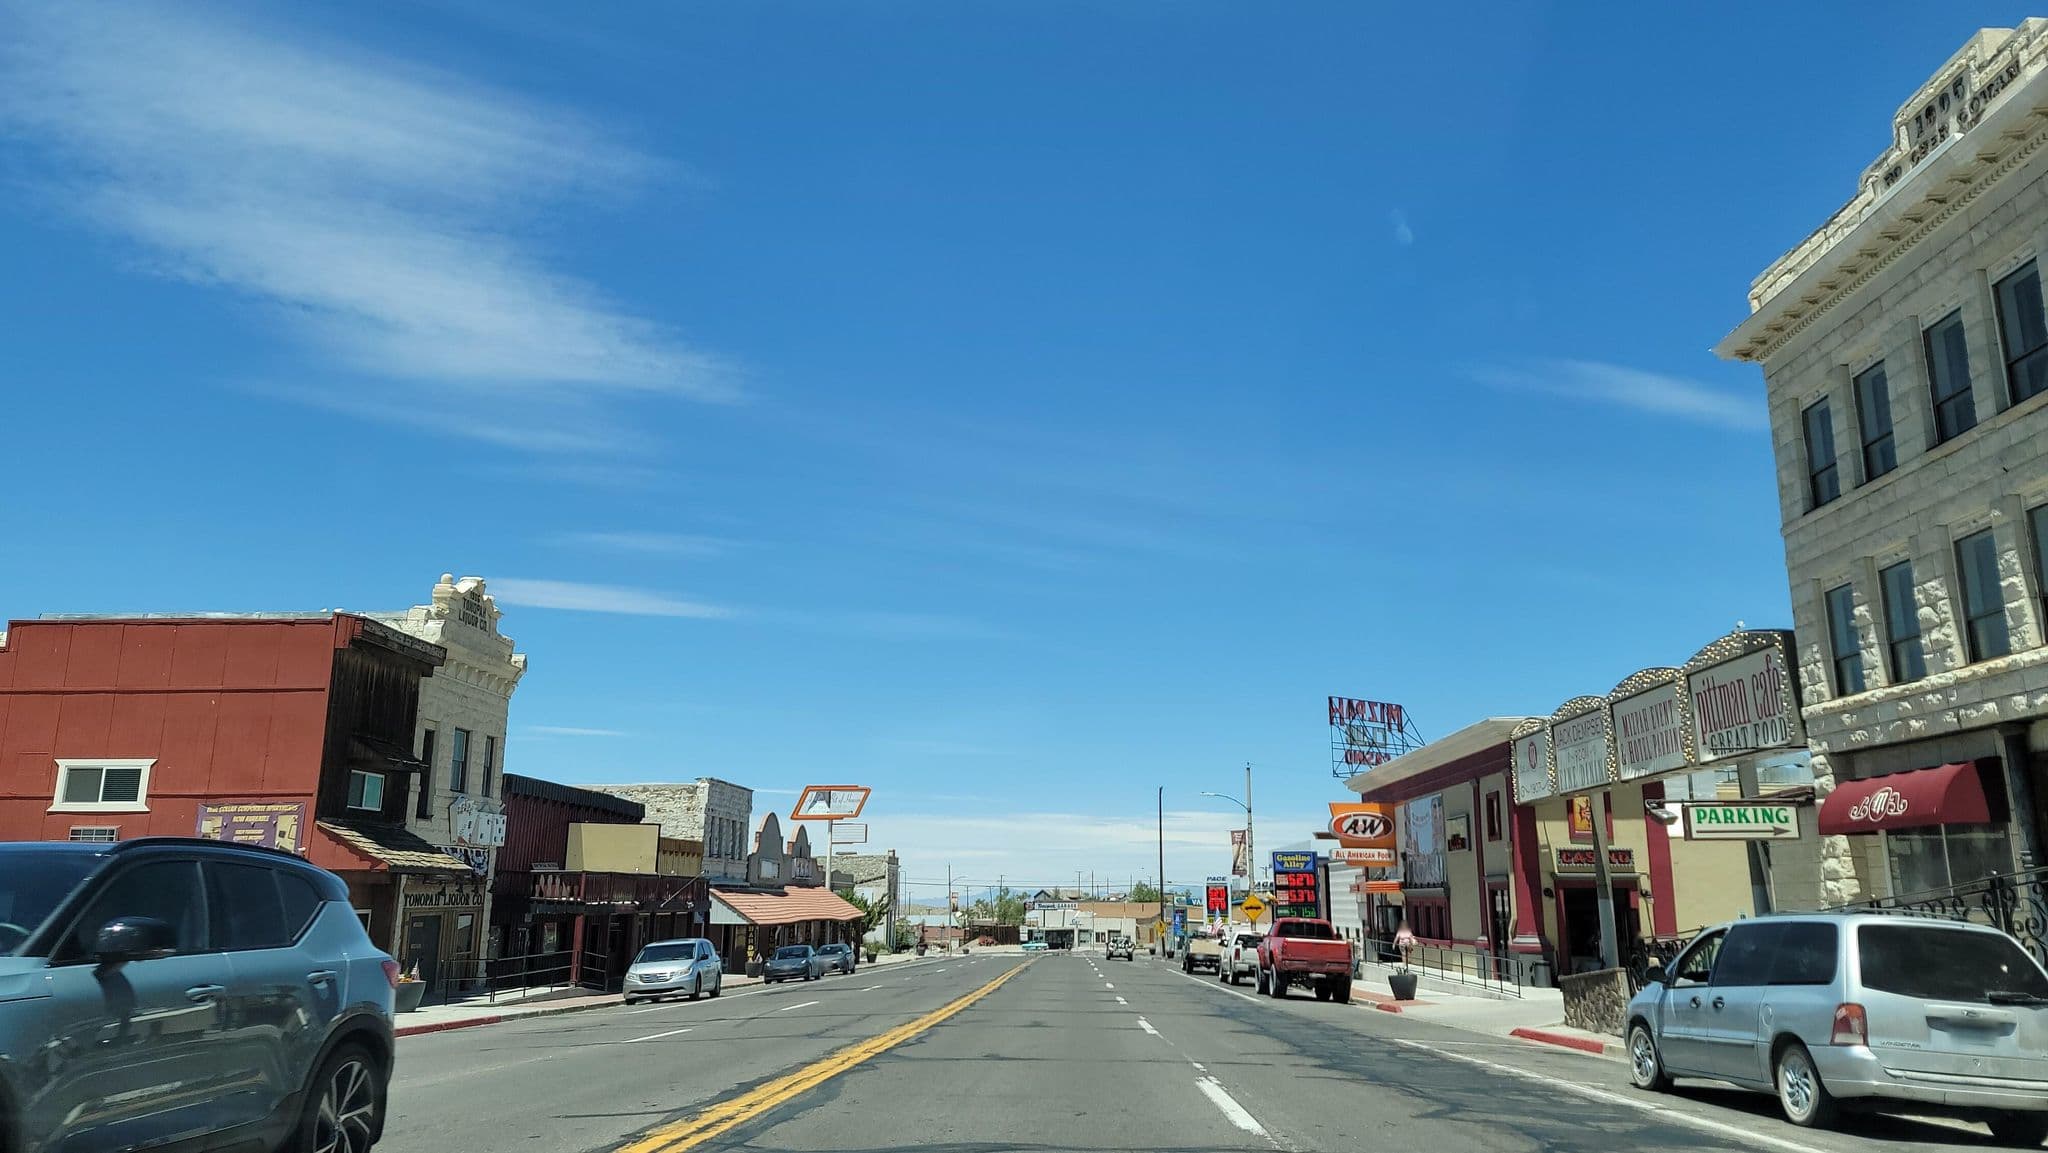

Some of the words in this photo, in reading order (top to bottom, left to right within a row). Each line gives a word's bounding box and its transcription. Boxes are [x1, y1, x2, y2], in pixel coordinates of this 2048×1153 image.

[463, 597, 488, 618] TONOPAH
[458, 608, 479, 628] LIQUOR
[1695, 675, 1752, 745] pittman
[1752, 653, 1785, 720] cafe
[1621, 708, 1650, 738] MIZPAH
[1649, 699, 1675, 729] EVENT
[1709, 727, 1750, 756] GREAT
[1754, 716, 1788, 747] FOOD
[1620, 743, 1627, 765] &
[1627, 735, 1653, 764] HOTEL
[1580, 758, 1605, 786] DININ
[1695, 807, 1790, 824] PARKING
[1276, 854, 1311, 862] Gasoline
[1283, 860, 1305, 869] Alley
[1335, 851, 1345, 859] ALL
[1347, 850, 1376, 860] AMERICAN
[1377, 851, 1392, 860] FOOD
[1561, 851, 1629, 864] CASNO
[404, 893, 441, 907] TONOPAH
[443, 893, 470, 906] LIQUOR
[472, 893, 484, 906] CO.
